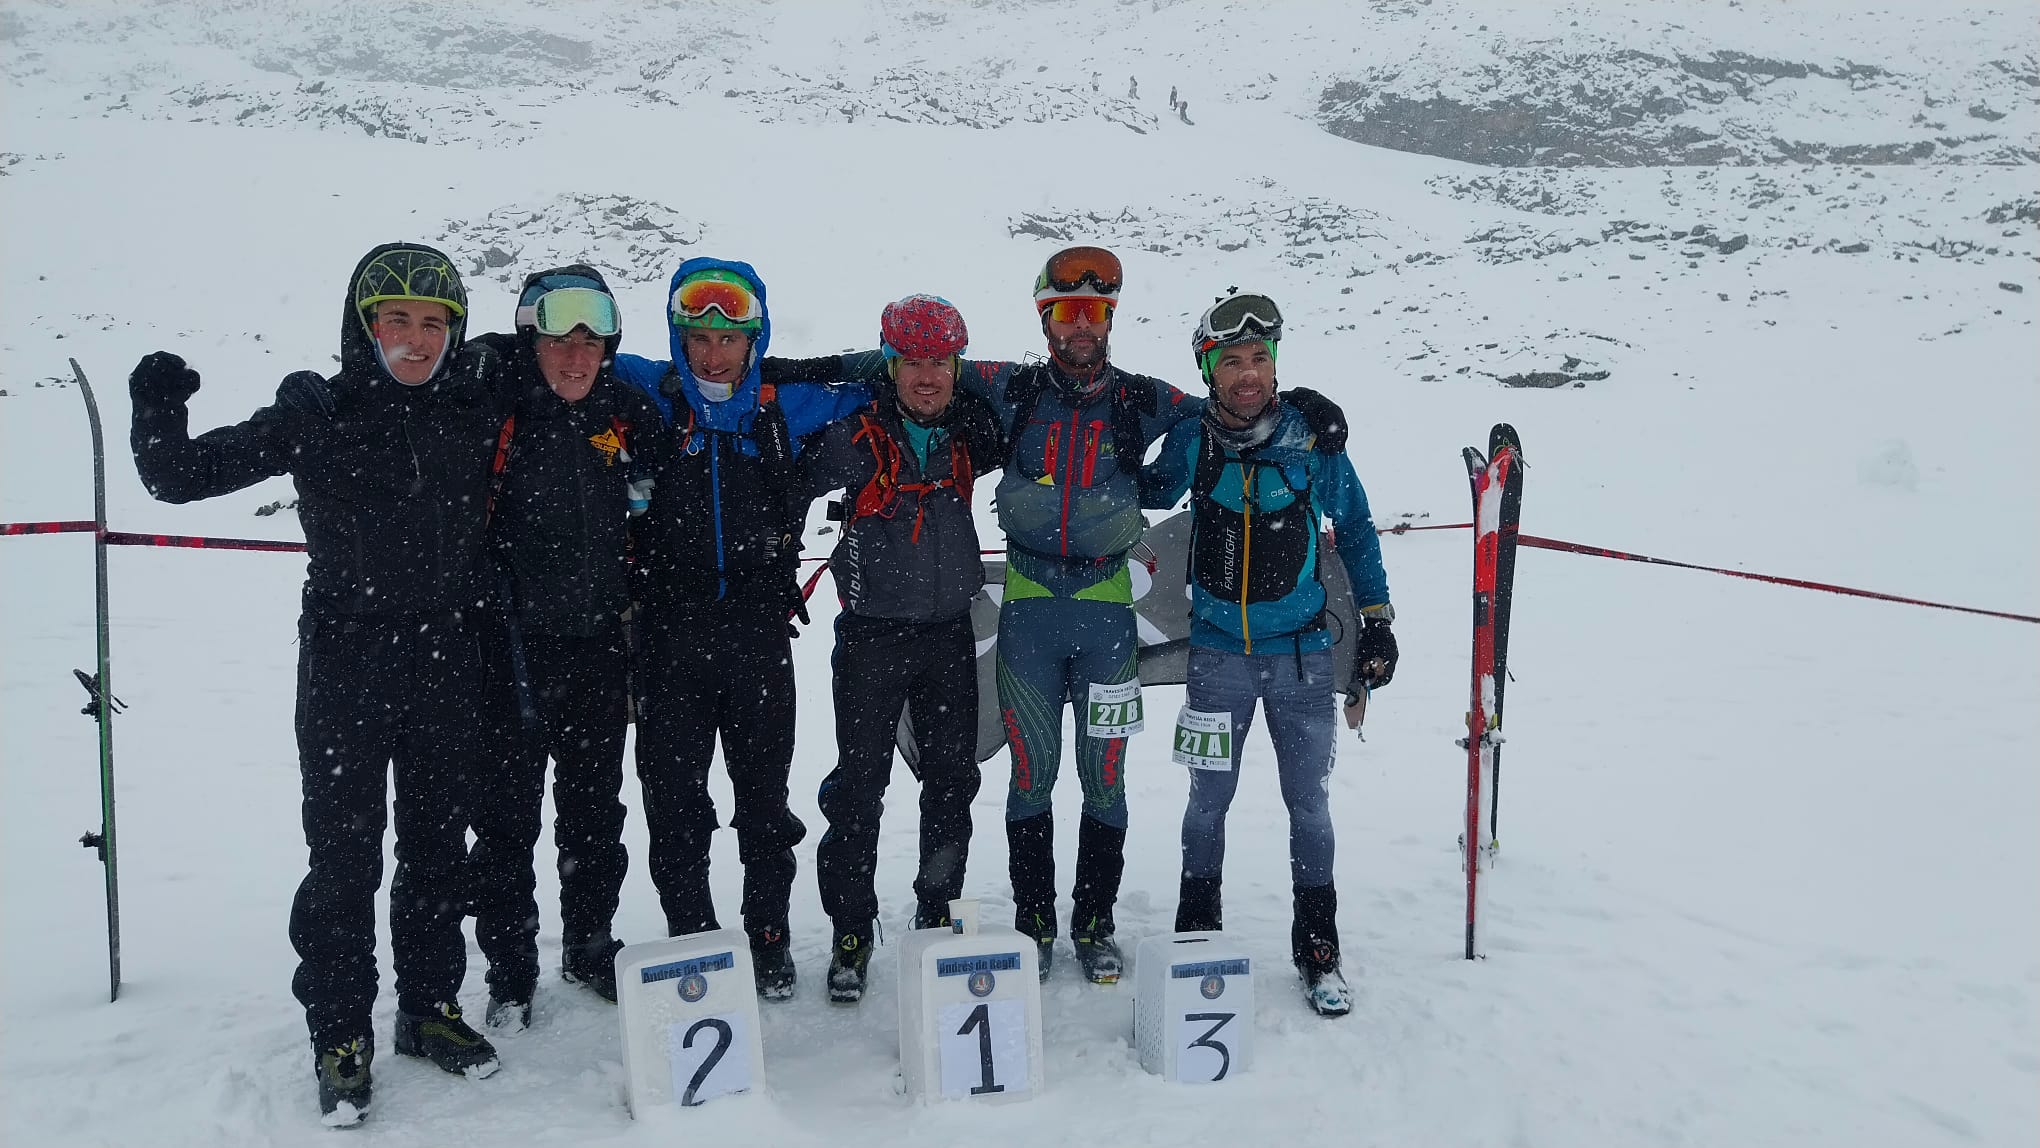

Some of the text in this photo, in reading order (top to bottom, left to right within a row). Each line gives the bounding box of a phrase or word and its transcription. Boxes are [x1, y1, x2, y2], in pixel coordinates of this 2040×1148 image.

[1097, 700, 1138, 725] 27 B
[1180, 729, 1223, 757] 27 A
[642, 967, 681, 984] Andrés
[683, 964, 699, 977] de
[681, 1018, 733, 1107] 2
[956, 1003, 1005, 1095] 1
[1184, 1012, 1237, 1082] 3
